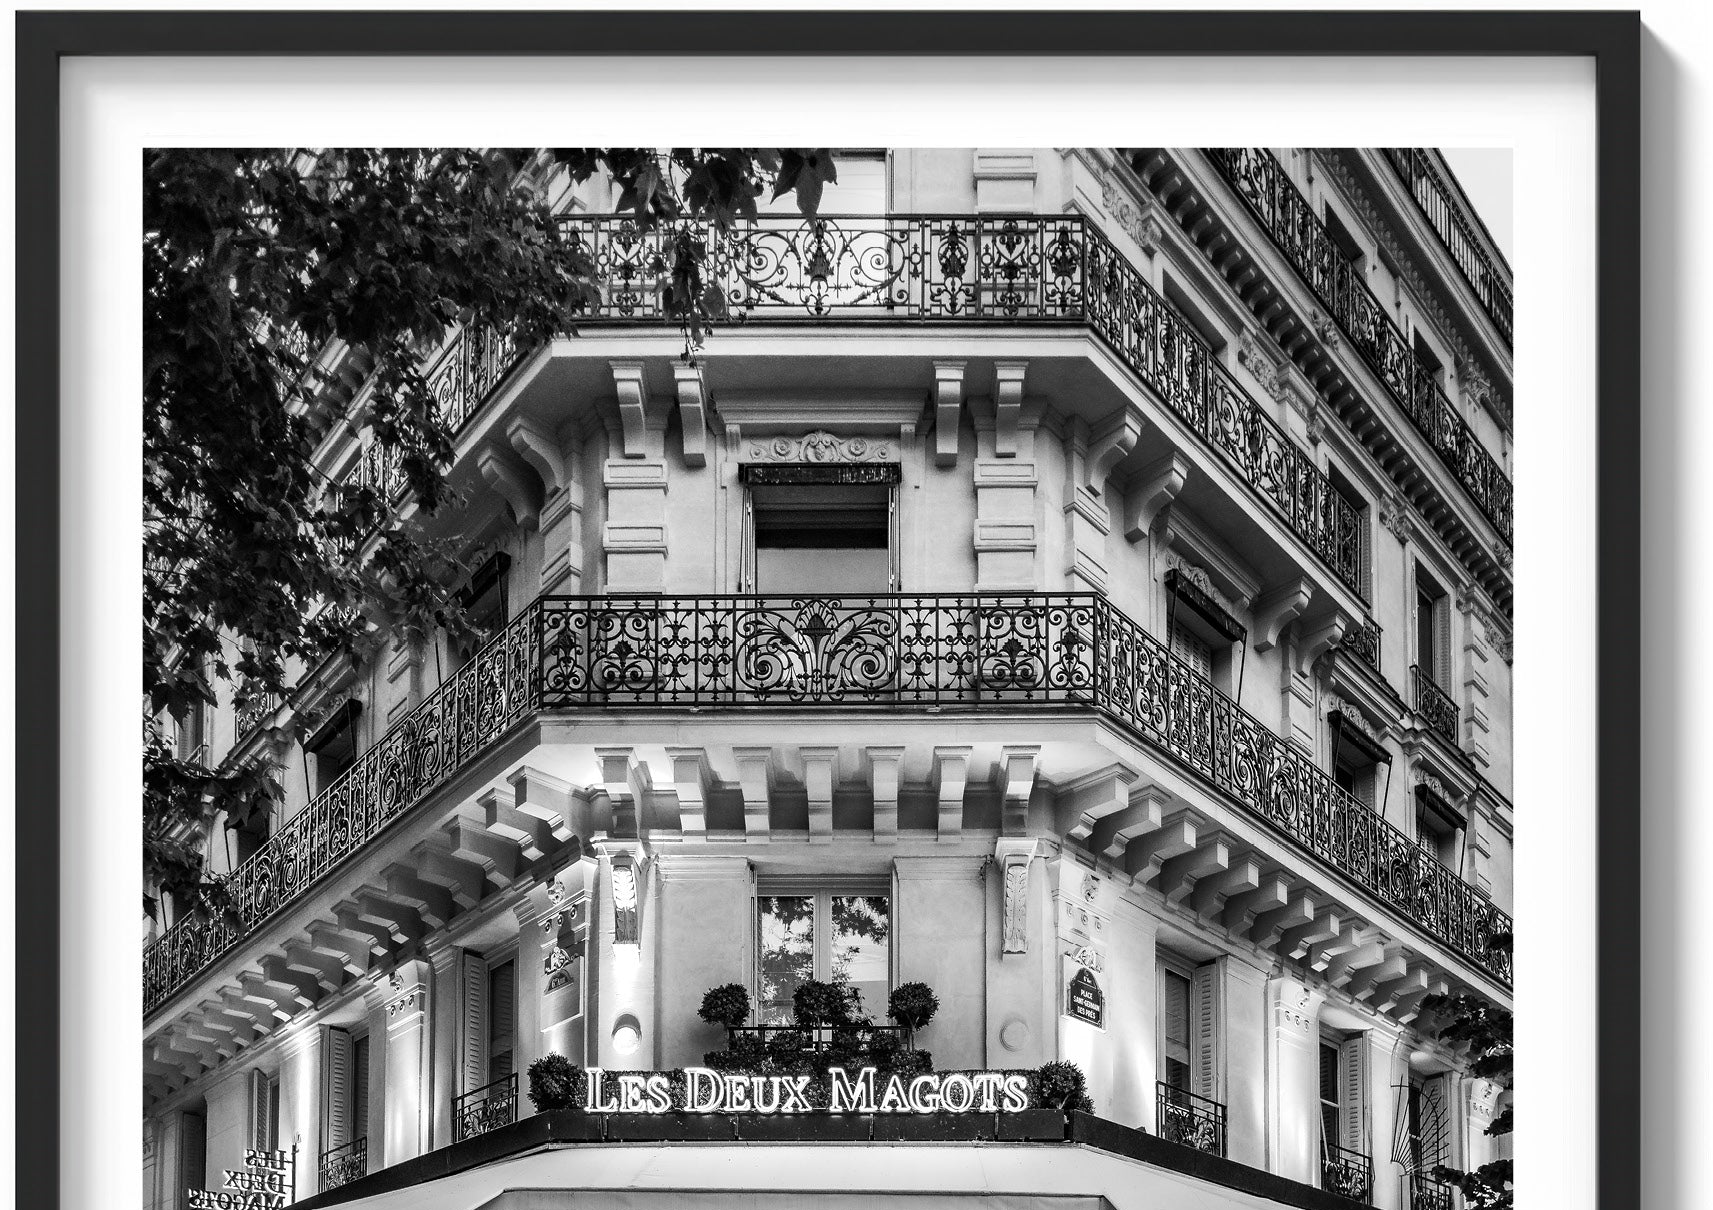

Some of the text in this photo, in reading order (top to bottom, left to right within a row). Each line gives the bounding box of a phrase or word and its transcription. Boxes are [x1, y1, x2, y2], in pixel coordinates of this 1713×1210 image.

[1080, 988, 1093, 1001] PLACE
[584, 1067, 1029, 1114] LES DEUX MAGOTS
